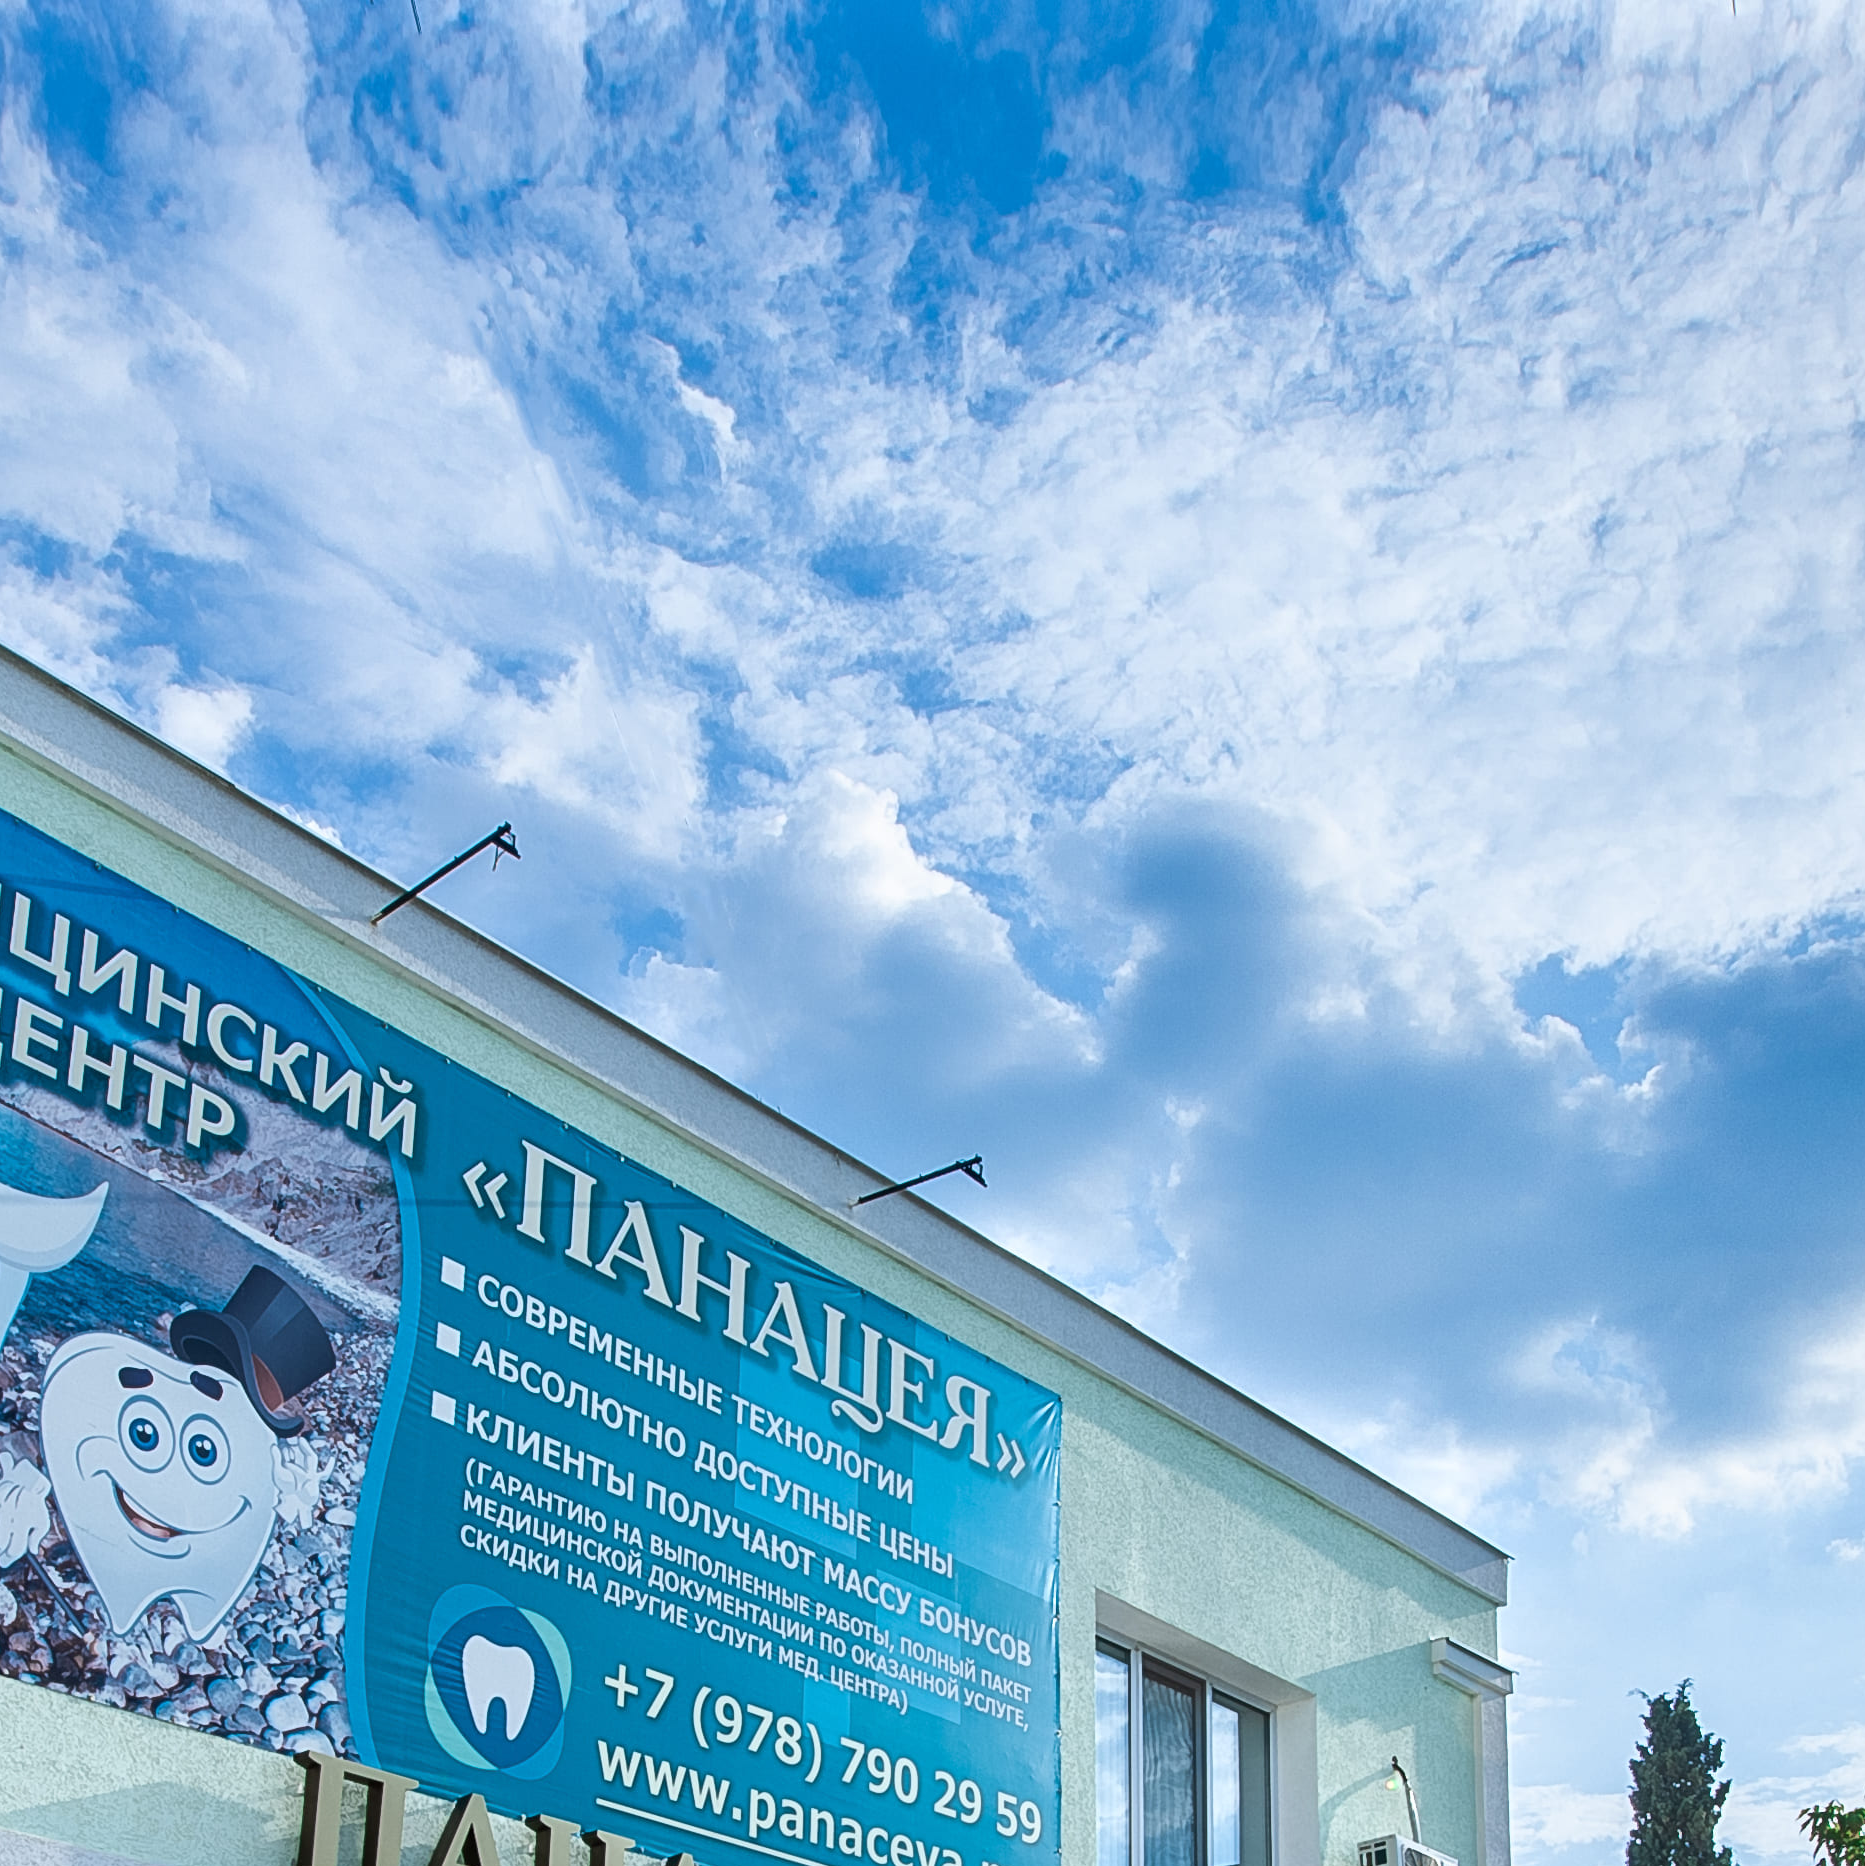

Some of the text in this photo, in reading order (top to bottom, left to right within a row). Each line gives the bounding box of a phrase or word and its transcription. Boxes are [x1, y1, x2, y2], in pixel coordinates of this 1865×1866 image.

[462, 1140, 1026, 1479] «ПАНАЦЕЯ»
[477, 1274, 914, 1504] СОВРЕМЕННЫЕ ТЕХНОЛОГИИ
[464, 1457, 1032, 1704] (ГАРАНТИЮ НА ВЫПОЛНЕННЫЕ РАБОТЫ, ПОЛНЫЙ ПАКЕТ
[465, 1402, 1032, 1667] КЛИЕНТЫ ПОЛУЧАЮТ МАССУ БОНУСОВ
[470, 1342, 954, 1579] АБСОЛЮТНО ДОСТУПНЫЕ ЦЕНЫ
[460, 1524, 908, 1715] СКИДКИ НА ДРУГИЕ УСЛУГИ МЕД. ЦЕНТРА)
[463, 1489, 1029, 1732] МЕДИЦИНСКОЙ ДОКУМЕНТАЦИИ ПО ОКАЗАННОЙ УСЛУГЕ,
[604, 1663, 1043, 1845] +7 (978) 790 29 59
